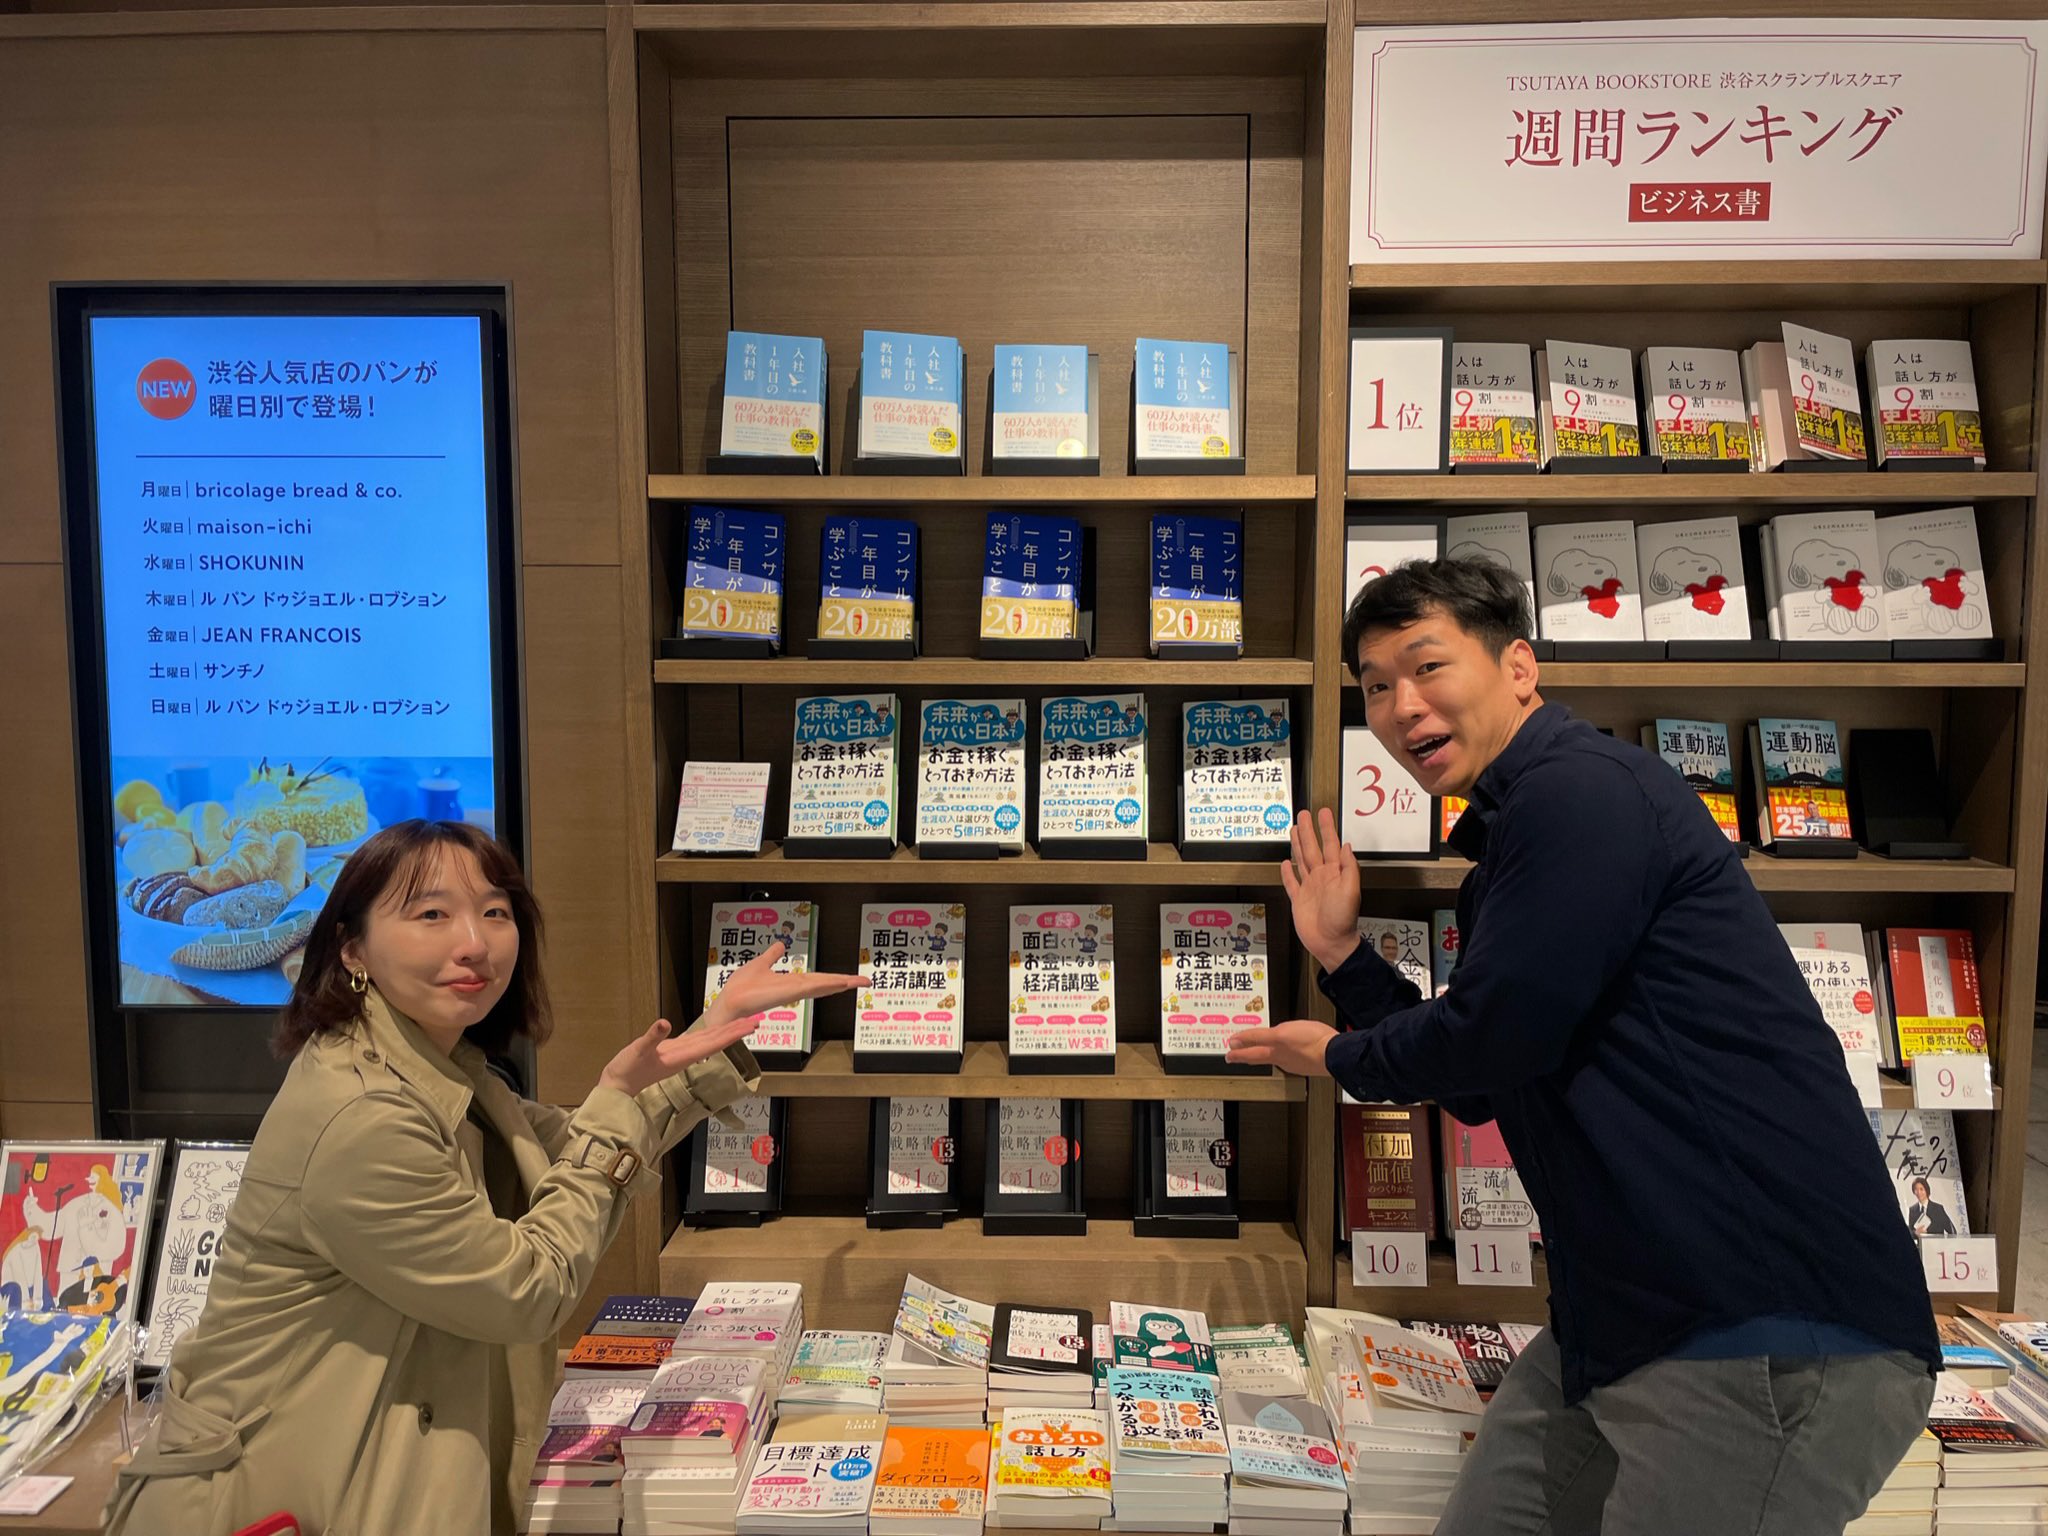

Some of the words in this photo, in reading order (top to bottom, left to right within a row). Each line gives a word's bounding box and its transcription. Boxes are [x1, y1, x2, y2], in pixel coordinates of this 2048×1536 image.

[1507, 73, 1590, 92] TSUTAYA
[1595, 72, 1711, 91] BOOKSTORE
[1719, 71, 1903, 89] 渋谷スクランブルスクエア
[1504, 105, 1905, 168] 週間ランキング
[1638, 188, 1762, 217] ビジネス書
[1799, 340, 1818, 354] 人は
[743, 343, 757, 381] 教科書
[1456, 356, 1483, 368] 人は
[1564, 355, 1589, 368] 人は
[1667, 360, 1694, 372] 人は
[1800, 357, 1844, 379] 話し方が
[1893, 353, 1923, 365] 人は
[207, 360, 438, 385] 渋谷人気店のパンが
[1456, 374, 1516, 386] 話し方が
[1565, 373, 1619, 389] 話し方が
[1895, 370, 1958, 382] 話し方が
[142, 380, 192, 399] NEW
[1669, 378, 1727, 390] 話し方が
[1800, 374, 1829, 400] 9割
[209, 394, 376, 419] 曜日別で登場！
[1367, 377, 1424, 432] 1位
[1455, 391, 1492, 416] 9割
[1564, 389, 1597, 415] 9割
[1667, 393, 1705, 420] 9割
[1894, 387, 1933, 410] 9割
[141, 481, 182, 498] 月曜日
[195, 482, 286, 501] bricolage
[293, 482, 348, 498] bread
[356, 483, 368, 498] &
[374, 485, 403, 498] co.
[142, 518, 184, 535] 火曜日
[197, 518, 312, 535] maison-ichi
[692, 517, 711, 589] 学ぶこと
[726, 525, 745, 592] 一年目が
[761, 525, 778, 594] コンサル
[990, 523, 1007, 593] 学ぶこと
[1156, 526, 1173, 598] 学ぶこと
[144, 554, 186, 571] 水曜日
[199, 554, 304, 571] SHOKUNIN
[828, 527, 845, 598] 学ぶこと
[861, 533, 878, 599] 一年目が
[895, 532, 911, 600] コンサル
[1021, 530, 1040, 596] 一年目が
[1055, 529, 1072, 597] コンサル
[1188, 533, 1205, 600] 一年目が
[1222, 531, 1239, 600] コンサル
[145, 591, 188, 607] 木曜日
[687, 595, 777, 630] 20万部
[824, 605, 912, 637] 20万部
[984, 604, 1073, 640] 20万部
[1156, 606, 1241, 640] 20万部
[147, 627, 189, 643] 金曜日
[201, 627, 253, 643] JEAN
[260, 627, 362, 643] FRANCOIS
[149, 663, 190, 680] 土曜日
[203, 663, 265, 680] サンチノ
[151, 698, 192, 715] 日曜日
[804, 702, 852, 720] 未来が
[931, 706, 981, 724] 未来が
[1051, 703, 1100, 721] 未来が
[1194, 708, 1245, 725] 未来が
[801, 718, 888, 739] ヤバい日本で
[928, 723, 1018, 741] ヤバい日本で
[1048, 718, 1137, 738] ヤバい日本で
[1191, 723, 1284, 741] ヤバい日本で
[800, 742, 878, 762] お金を稼ぐ
[1662, 731, 1727, 758] 運動脳
[1766, 731, 1837, 755] 運動脳
[928, 746, 1009, 765] お金を稼ぐ
[1049, 743, 1129, 762] お金を稼ぐ
[1193, 747, 1275, 765] お金を稼ぐ
[1682, 755, 1714, 767] BRAIN
[797, 763, 885, 780] とっておきの方法
[925, 767, 1016, 783] とっておきの方法
[1046, 763, 1135, 779] とっておきの方法
[1190, 768, 1283, 784] とっておきの方法
[1354, 764, 1418, 817] 3位
[793, 811, 860, 822] 生涯収入は選び方
[921, 815, 991, 824] 生涯収入は選び方
[1043, 808, 1111, 818] 生涯収入は選び方
[743, 912, 774, 923] 世界一
[721, 928, 772, 946] 面白くて
[872, 929, 925, 947] 面白くて
[1022, 931, 1075, 950] 面白くて
[1174, 930, 1228, 948] 面白くて
[872, 950, 943, 968] お金になる
[1023, 952, 1095, 971] お金になる
[1175, 951, 1249, 970] お金になる
[1798, 960, 1851, 974] 限りある
[871, 971, 946, 990] 経済講座
[1023, 973, 1099, 992] 経済講座
[1174, 972, 1253, 992] 経済講座
[1919, 1035, 1967, 1046] 1番売れた
[1937, 1068, 1974, 1098] 9位
[890, 1103, 949, 1118] 静かな人
[1000, 1104, 1061, 1120] 静かな人
[1166, 1107, 1225, 1121] 静かな人
[709, 1122, 721, 1133] の
[708, 1134, 753, 1150] 戦略書
[890, 1135, 934, 1150] 戦略書
[1000, 1136, 1047, 1151] 戦略書
[1166, 1139, 1211, 1153] 戦略書
[1367, 1134, 1410, 1157] 付加
[1367, 1160, 1413, 1184] 価値
[1461, 1168, 1479, 1205] 三流
[1368, 1211, 1409, 1222] キーエンス
[1366, 1244, 1418, 1275] 10位
[1470, 1243, 1523, 1275] 11位
[1937, 1251, 1988, 1281] 15位
[720, 1288, 789, 1296] リーダーは
[1465, 1322, 1512, 1363] 物価
[669, 1362, 750, 1373] SHIBUYA
[664, 1372, 746, 1386] 109式
[1138, 1381, 1185, 1392] スマホ
[1112, 1382, 1138, 1424] つながる
[1190, 1387, 1220, 1431] 読まれる
[1015, 1431, 1098, 1443] おもろい
[1140, 1425, 1204, 1440] 文章術
[764, 1445, 872, 1461] 目標達成
[1025, 1445, 1088, 1457] 話し方
[755, 1463, 828, 1478] ノート
[881, 1472, 984, 1484] ダイアローグ
[749, 1485, 825, 1495] 毎日の行動が
[745, 1494, 821, 1509] 変わる!
